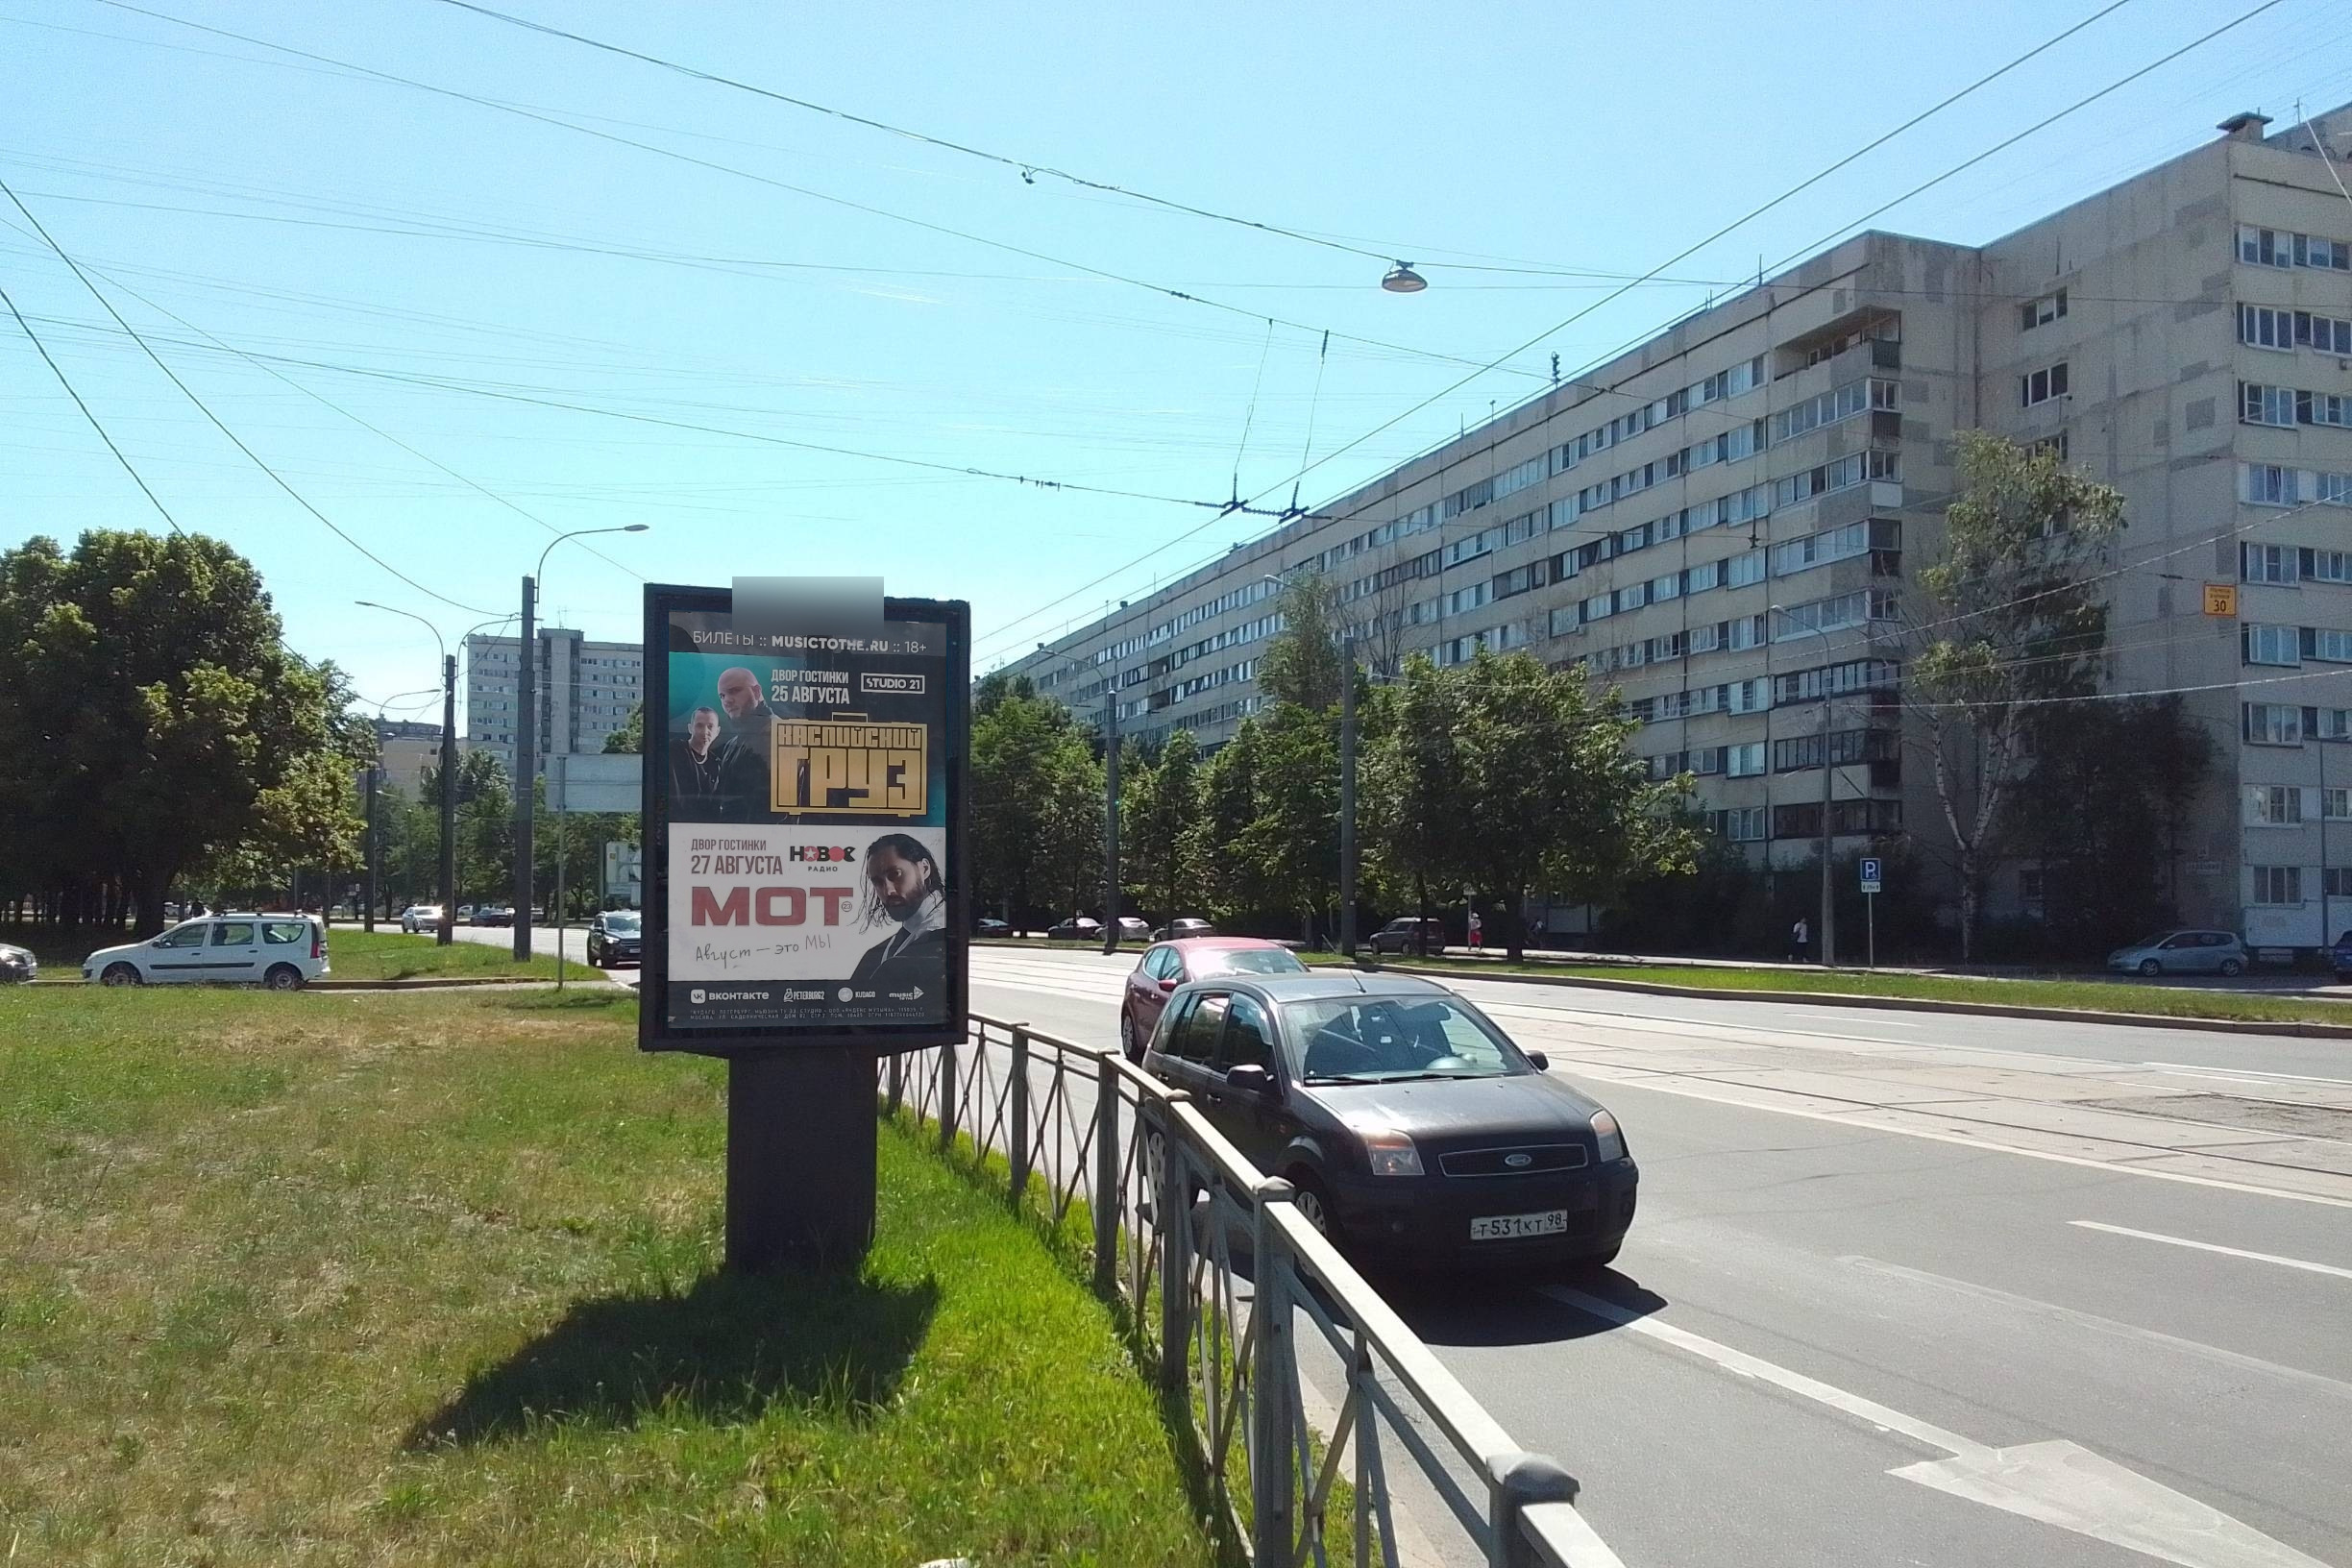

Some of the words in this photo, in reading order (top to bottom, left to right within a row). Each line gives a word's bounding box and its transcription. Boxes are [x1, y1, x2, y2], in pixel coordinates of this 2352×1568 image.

[2213, 600, 2227, 612] 30
[772, 634, 889, 652] MUSICTOTHE.RU
[904, 641, 927, 653] 18+
[771, 669, 797, 682] ДВОР
[798, 670, 849, 684] ГОСТИНКИ
[866, 677, 907, 689] STUDIO
[909, 679, 920, 690] 21
[771, 685, 789, 702] 25
[792, 686, 850, 704] АВГУСТА
[777, 724, 921, 749] КАСПИЙСКИЙ
[777, 747, 921, 809] ГРУЗ
[691, 839, 717, 851] ДВОР
[719, 839, 767, 851] ГОСТИНКИ
[691, 855, 711, 874] 27
[714, 855, 783, 875] АВГУСТА
[691, 886, 853, 926] МОТ
[696, 943, 751, 969] Август
[774, 943, 799, 955] это
[805, 934, 831, 950] МЫ
[1547, 1213, 1562, 1226] 98
